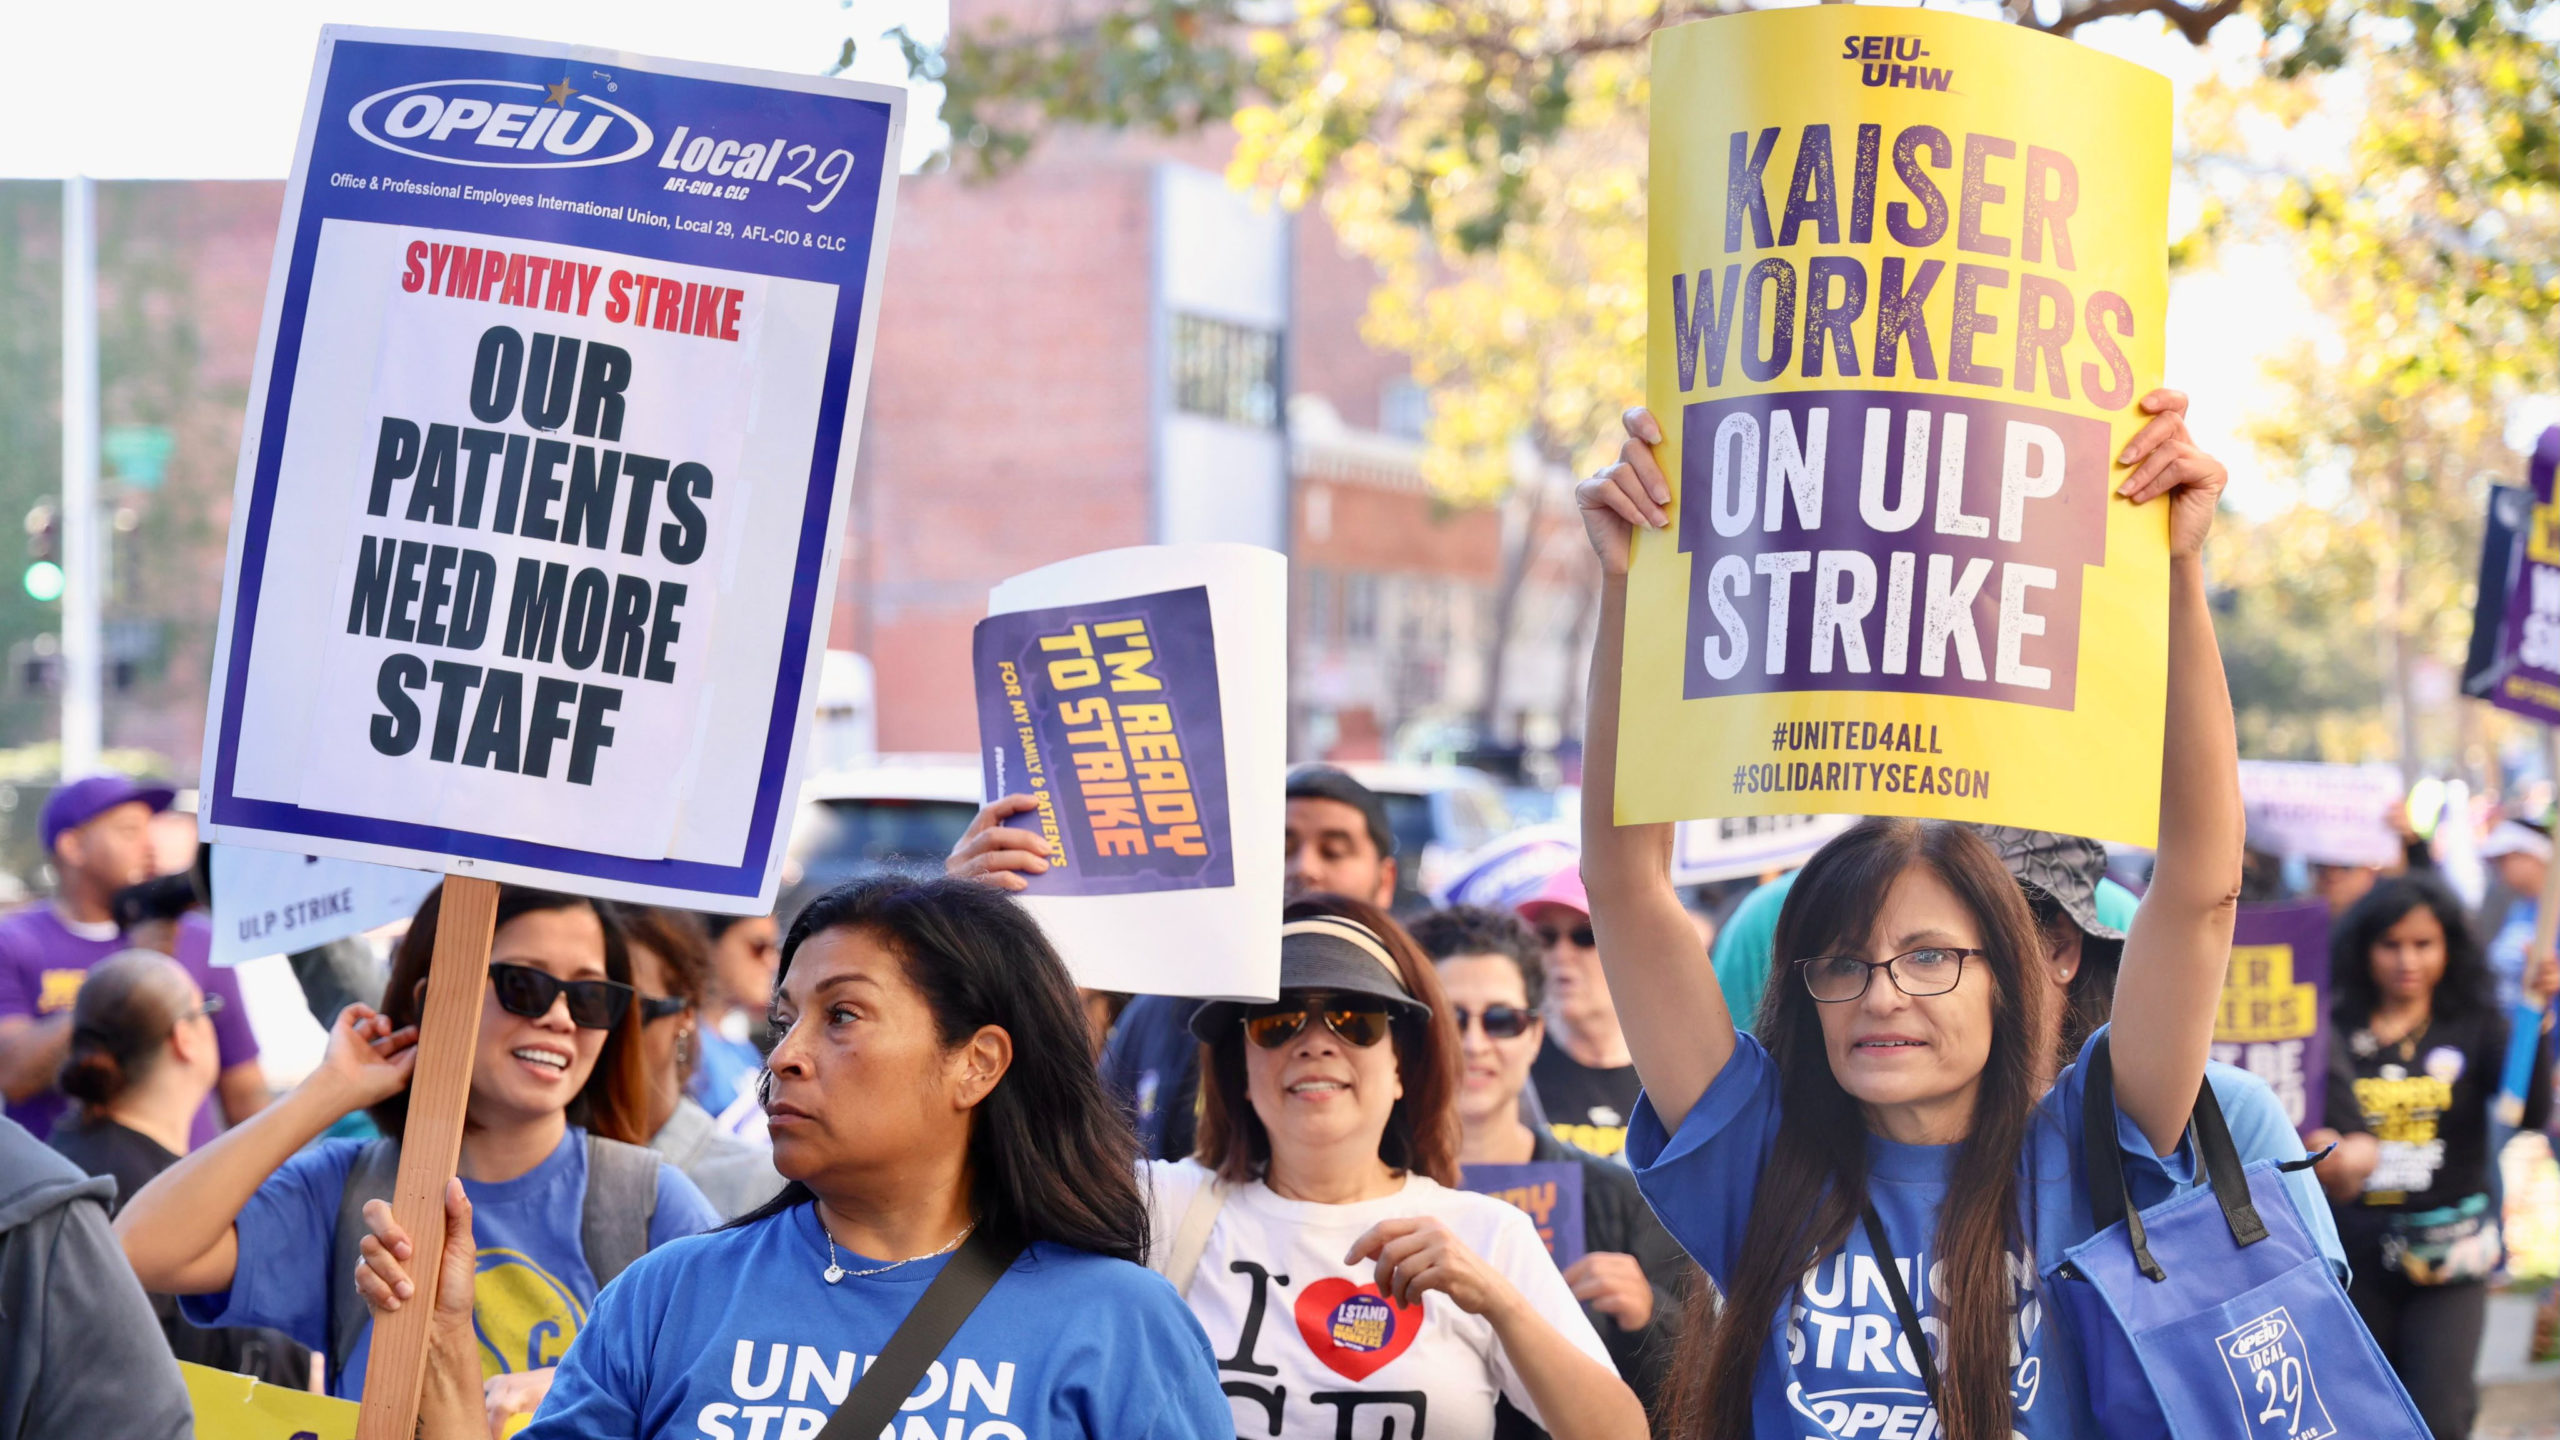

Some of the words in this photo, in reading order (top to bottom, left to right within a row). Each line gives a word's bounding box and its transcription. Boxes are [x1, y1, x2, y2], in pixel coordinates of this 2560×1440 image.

[1842, 35, 1930, 61] SEIU-
[1860, 63, 1953, 92] UHW
[384, 95, 613, 156] OPEIU
[658, 126, 787, 182] Local
[776, 144, 855, 213] 29
[664, 177, 713, 198] AFL-CIO
[713, 186, 724, 198] &
[724, 185, 751, 201] CLC
[1723, 123, 2080, 272] KAISER
[330, 172, 367, 189] Office
[369, 175, 379, 191] &
[382, 177, 461, 199] Professional
[463, 186, 534, 207] Employees
[537, 193, 624, 221] International
[627, 208, 671, 230] Union,
[674, 215, 712, 234] Local
[715, 221, 735, 239] 29,
[741, 225, 800, 246] AFL-CIO
[803, 235, 813, 247] &
[817, 235, 846, 251] CLC
[401, 240, 601, 317] SYMPATHY
[604, 269, 744, 341] STRIKE
[1672, 255, 2135, 411] WORKERS
[469, 325, 632, 441] OUR
[367, 416, 714, 565] PATIENTS
[1710, 407, 1829, 538] ON
[1859, 407, 2066, 543] ULP
[346, 535, 497, 651] NEED
[503, 557, 688, 683] MORE
[1703, 549, 2058, 690] STRIKE
[998, 661, 1021, 697] FOR
[1040, 624, 1102, 691] TO
[1094, 619, 1163, 692] I'M
[369, 653, 623, 786] STAFF
[1009, 700, 1031, 724] MY
[1018, 726, 1043, 774] FAMILY
[1771, 721, 1943, 755] #UNITED4ALL
[1030, 776, 1046, 788] &
[1059, 696, 1149, 857] STRIKE
[1117, 702, 1208, 857] READY
[1732, 762, 1990, 799] #SOLIDARITYSEASON
[1034, 790, 1068, 867] PATIENTS
[239, 909, 277, 940] ULP
[283, 887, 353, 930] STRIKE
[1217, 1260, 1290, 1376] I
[1346, 1304, 1389, 1321] STAND
[2248, 1342, 2286, 1373] LOCAL
[2255, 1357, 2302, 1435] 29
